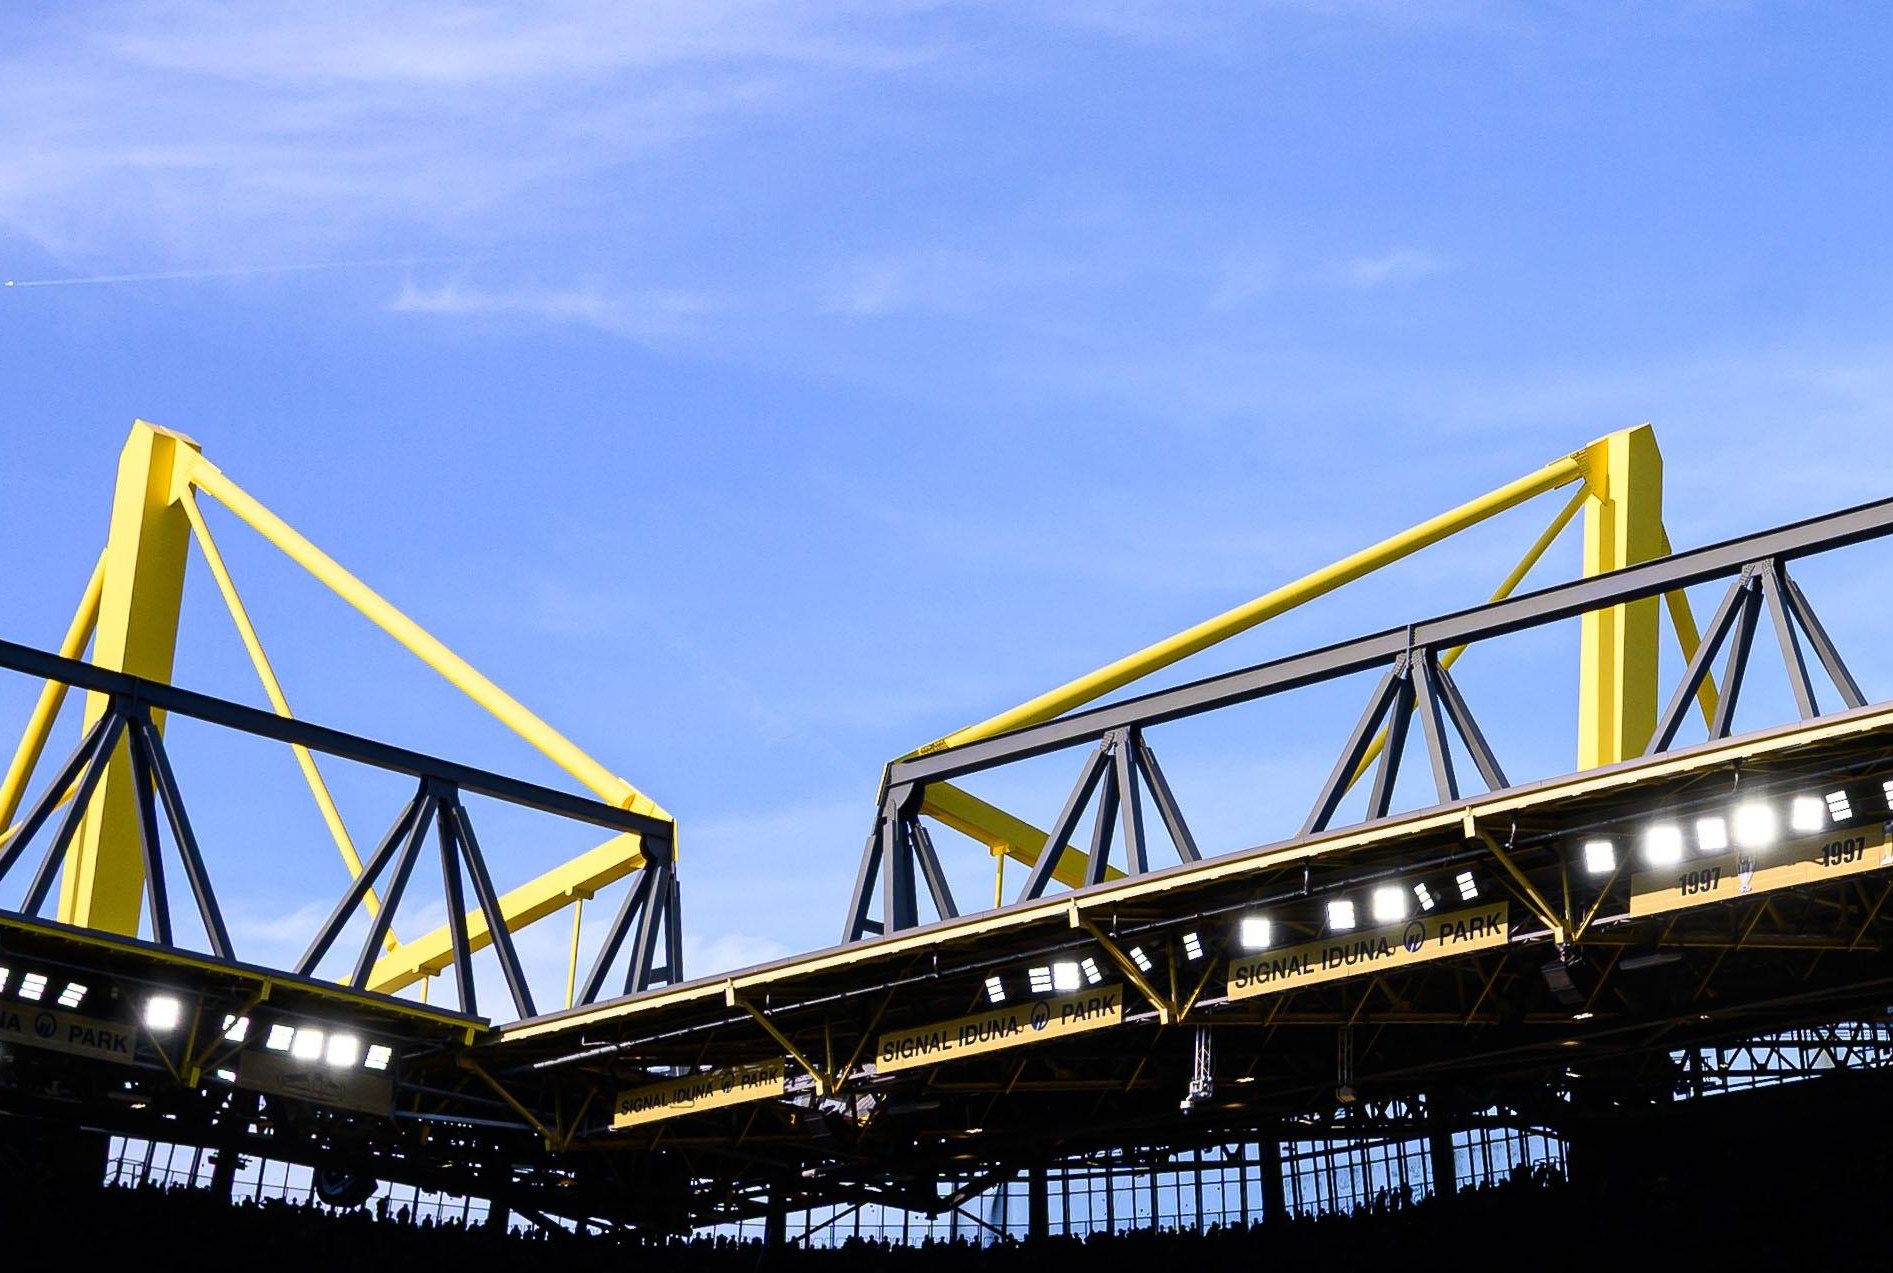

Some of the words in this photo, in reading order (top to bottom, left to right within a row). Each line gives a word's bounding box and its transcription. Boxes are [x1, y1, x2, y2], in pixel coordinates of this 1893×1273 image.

[1822, 836, 1866, 868] 1997
[1680, 867, 1721, 896] 1997
[1235, 952, 1315, 989] SIGNAL
[1321, 936, 1391, 970] IDUNA
[1439, 911, 1501, 946] PARK
[68, 1025, 128, 1053] PARK
[882, 1030, 952, 1063] SIGNAL
[959, 1016, 1019, 1048] IDUNA
[1061, 993, 1116, 1025] PARK
[621, 1090, 668, 1115] SIGNAL
[672, 1079, 714, 1104] IDUNA
[741, 1068, 778, 1090] PARK
